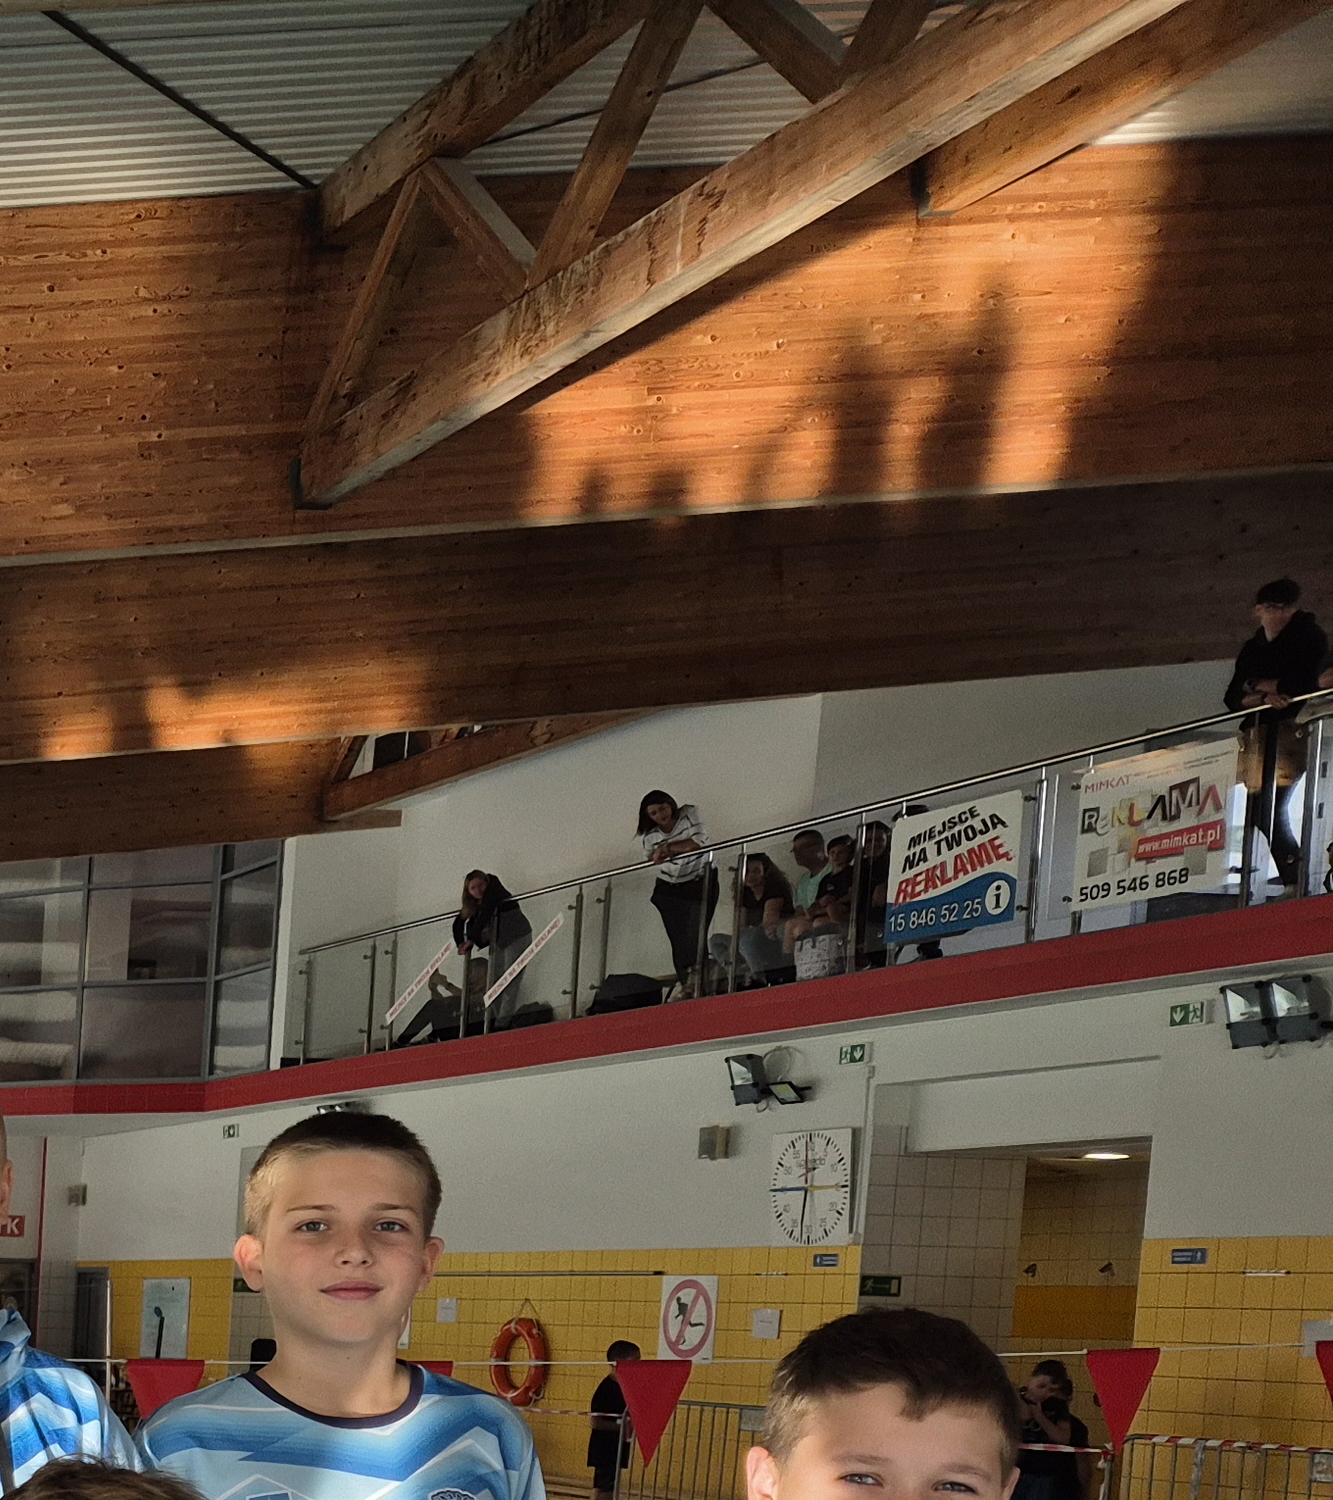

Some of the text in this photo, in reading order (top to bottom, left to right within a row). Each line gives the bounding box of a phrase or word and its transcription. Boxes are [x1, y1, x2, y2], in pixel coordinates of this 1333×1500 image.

[1084, 775, 1132, 794] MIMKAT
[907, 806, 980, 850] MIEJSCE
[1137, 825, 1221, 854] www.mimkat.pl
[902, 847, 928, 874] NA
[1079, 867, 1190, 903] 509 546 868
[889, 899, 982, 932] 15 846 52 25
